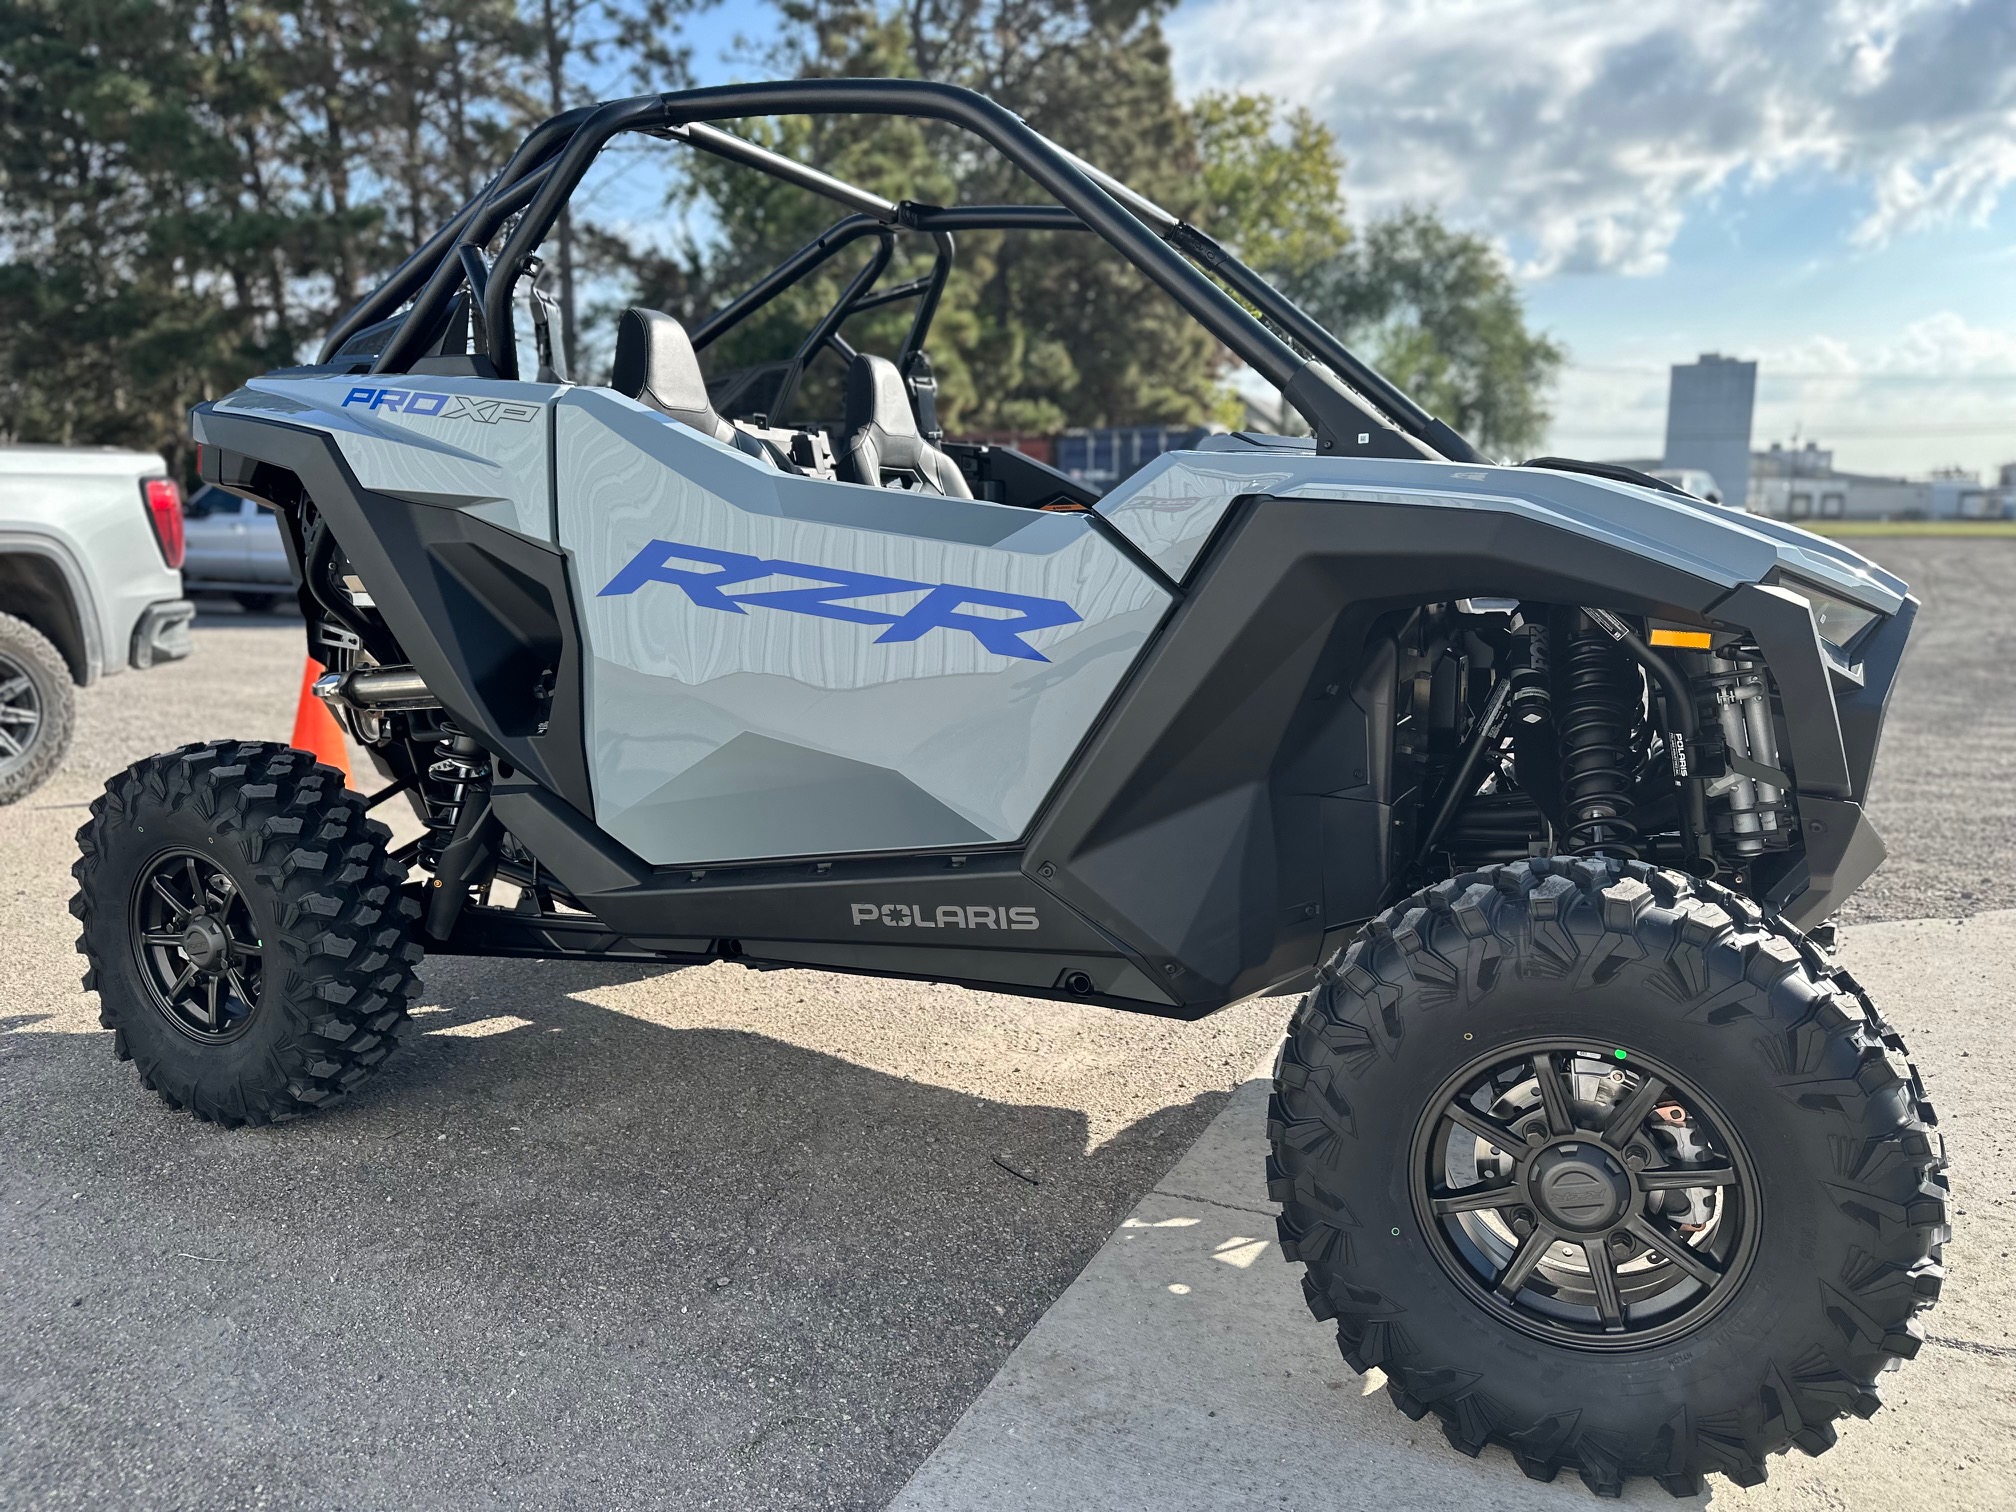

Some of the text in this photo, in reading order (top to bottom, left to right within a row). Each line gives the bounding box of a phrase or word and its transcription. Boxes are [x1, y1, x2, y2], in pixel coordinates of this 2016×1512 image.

[597, 539, 1083, 663] RZR
[1528, 626, 1550, 672] FOX
[1675, 733, 1688, 777] POLARIS
[851, 903, 1040, 931] POLARIS
